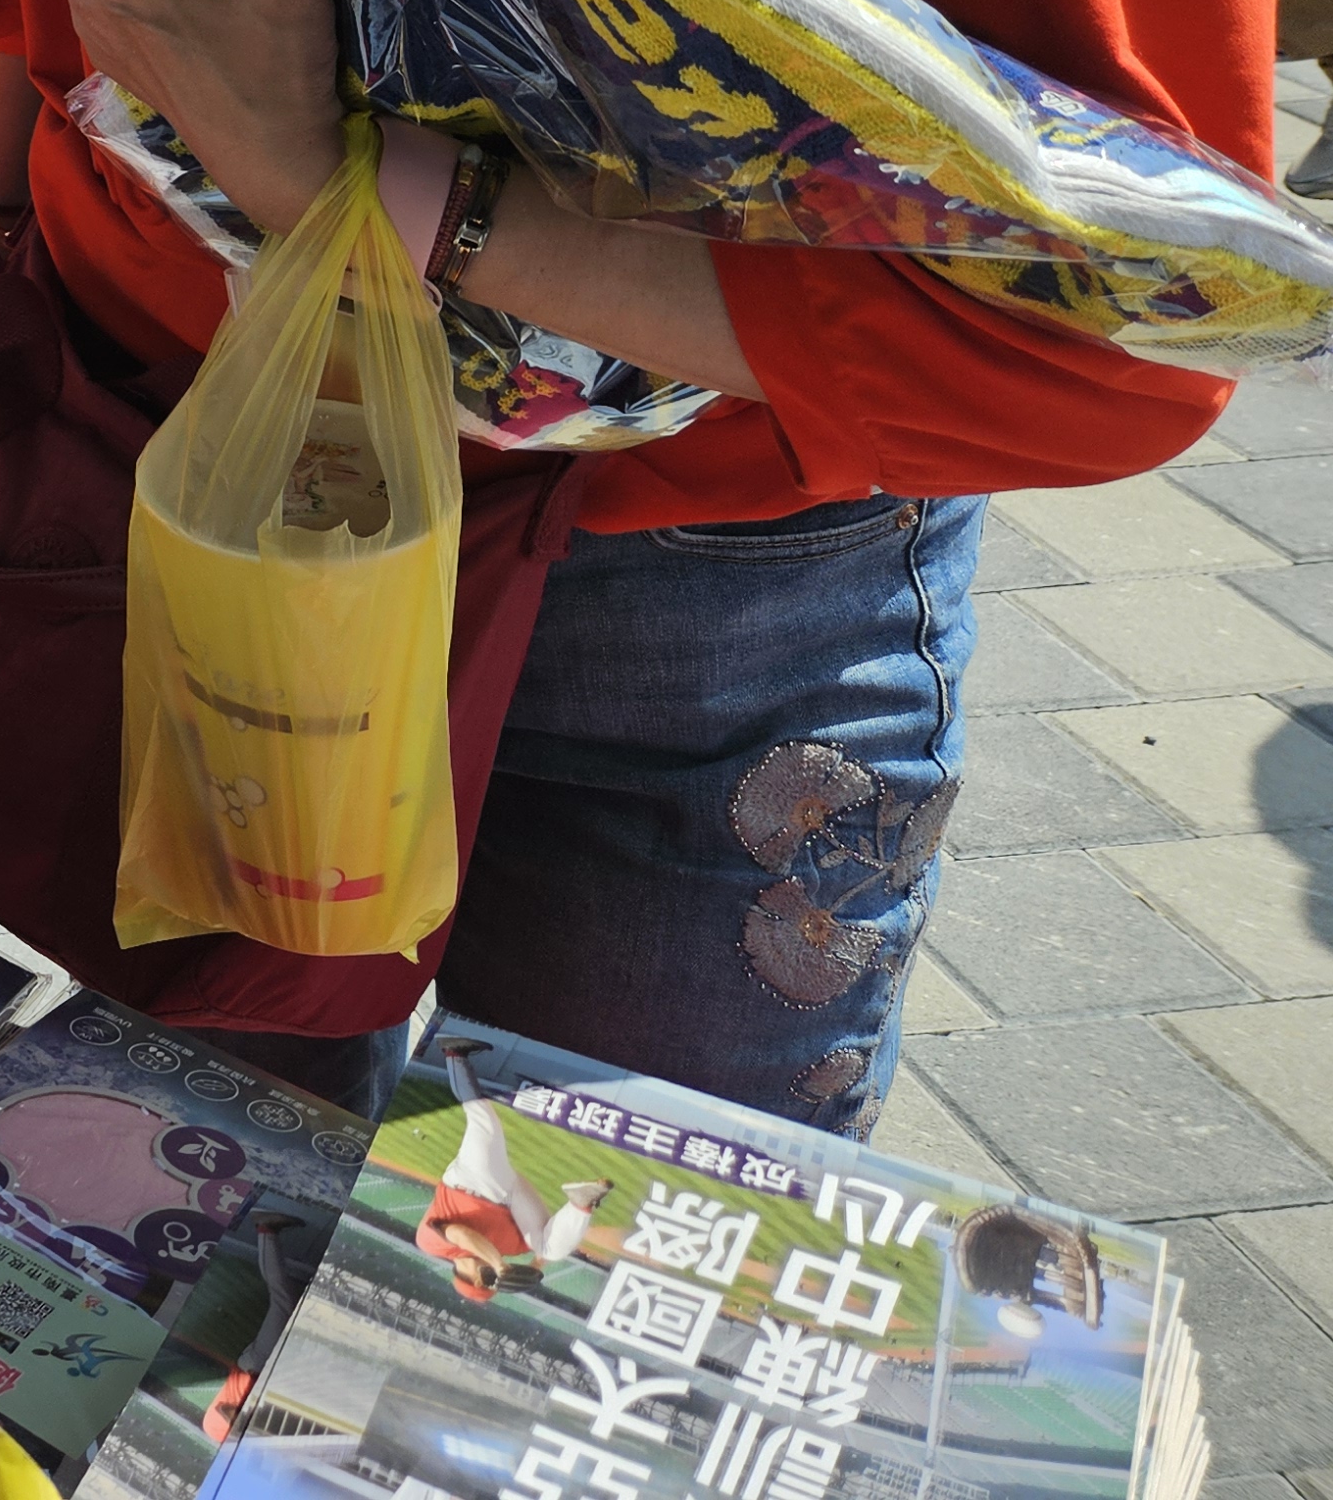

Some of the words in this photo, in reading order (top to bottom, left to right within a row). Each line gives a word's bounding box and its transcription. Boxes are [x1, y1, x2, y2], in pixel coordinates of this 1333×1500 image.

[509, 1080, 797, 1197] 成棒主球場
[692, 1171, 939, 1500] 訓練中心
